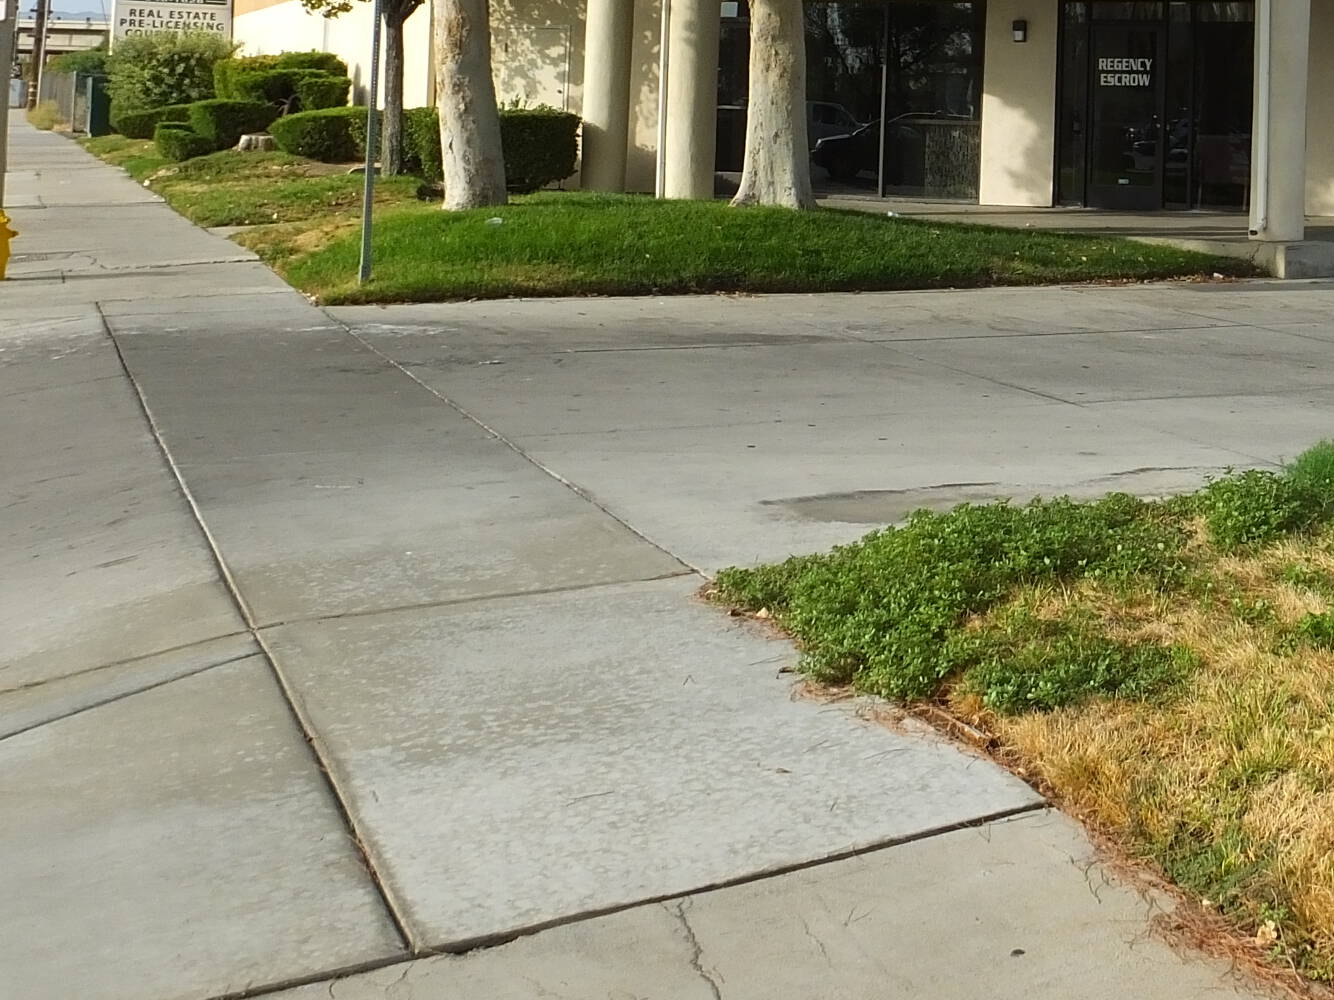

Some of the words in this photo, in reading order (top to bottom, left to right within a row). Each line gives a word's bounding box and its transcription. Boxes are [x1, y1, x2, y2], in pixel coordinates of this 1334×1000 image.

[129, 8, 163, 19] REAL
[169, 10, 217, 21] ESTATE
[119, 18, 225, 31] PRE-LICENSING
[1099, 58, 1152, 71] REGENCY
[1100, 73, 1151, 87] ESCROW
